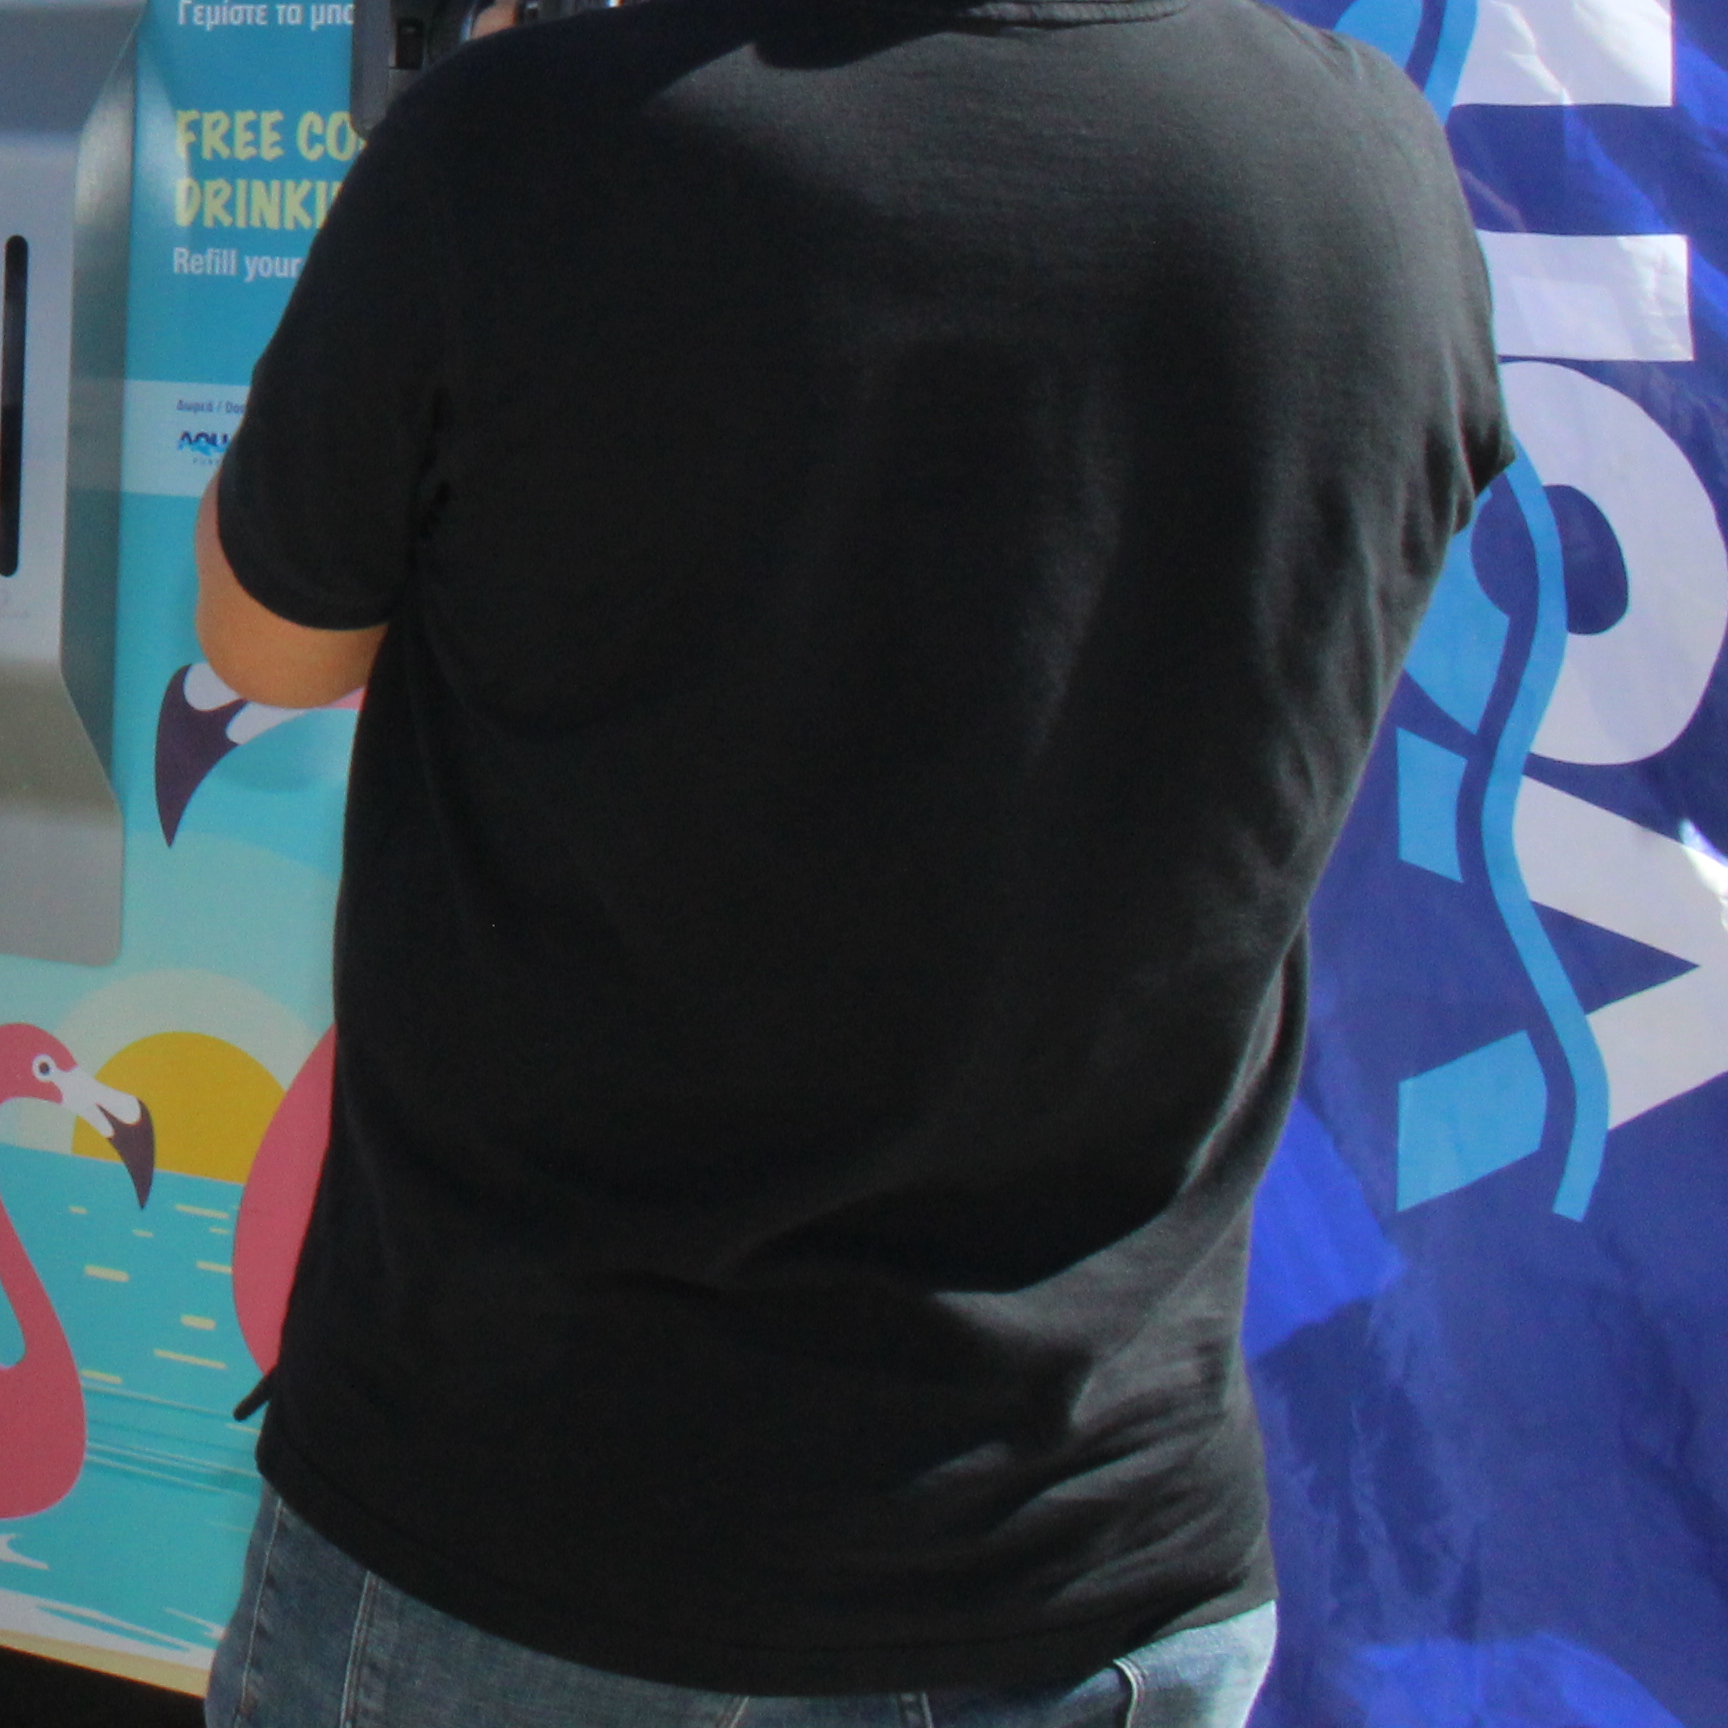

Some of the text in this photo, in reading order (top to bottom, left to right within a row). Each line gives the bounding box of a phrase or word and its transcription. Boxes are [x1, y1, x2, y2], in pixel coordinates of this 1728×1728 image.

[276, 5, 303, 24] τα
[176, 110, 368, 162] FREE CO
[175, 177, 344, 230] DRINKI
[173, 246, 305, 282] Refill your
